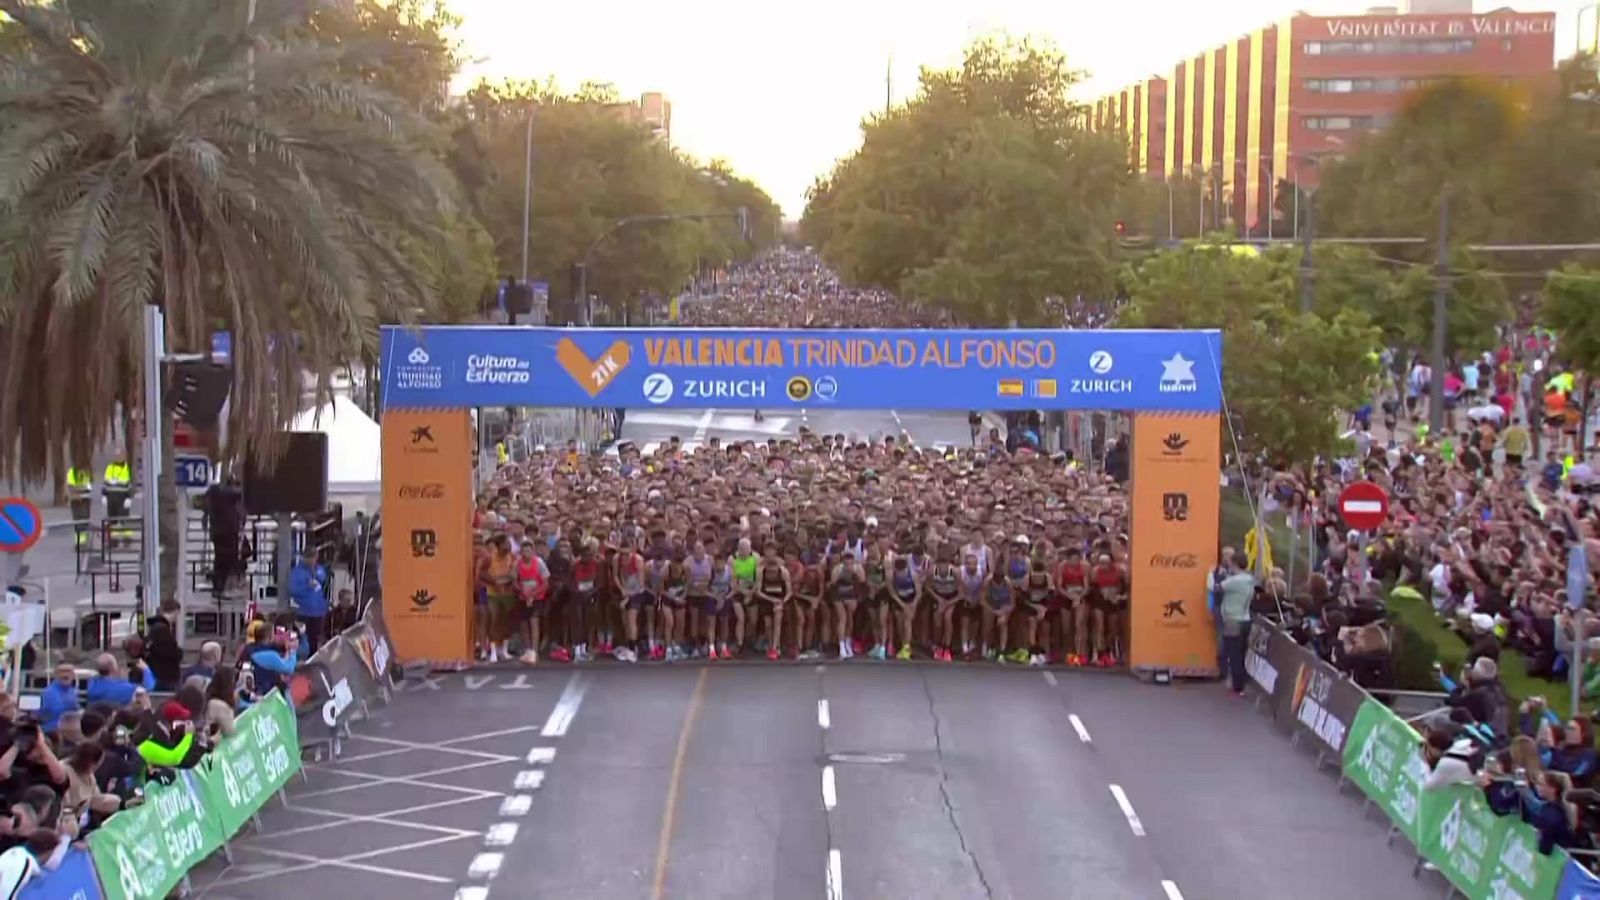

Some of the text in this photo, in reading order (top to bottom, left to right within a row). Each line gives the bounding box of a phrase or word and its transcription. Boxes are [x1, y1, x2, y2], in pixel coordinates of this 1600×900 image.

[467, 354, 518, 368] Cultura
[643, 338, 1056, 368] VALENCIA TRINIDAD ALFONSO
[466, 368, 530, 384] Esfuerzo
[591, 355, 620, 387] 21K
[683, 379, 766, 398] ZURICH
[1070, 379, 1133, 393] ZURICH
[186, 462, 206, 483] 14
